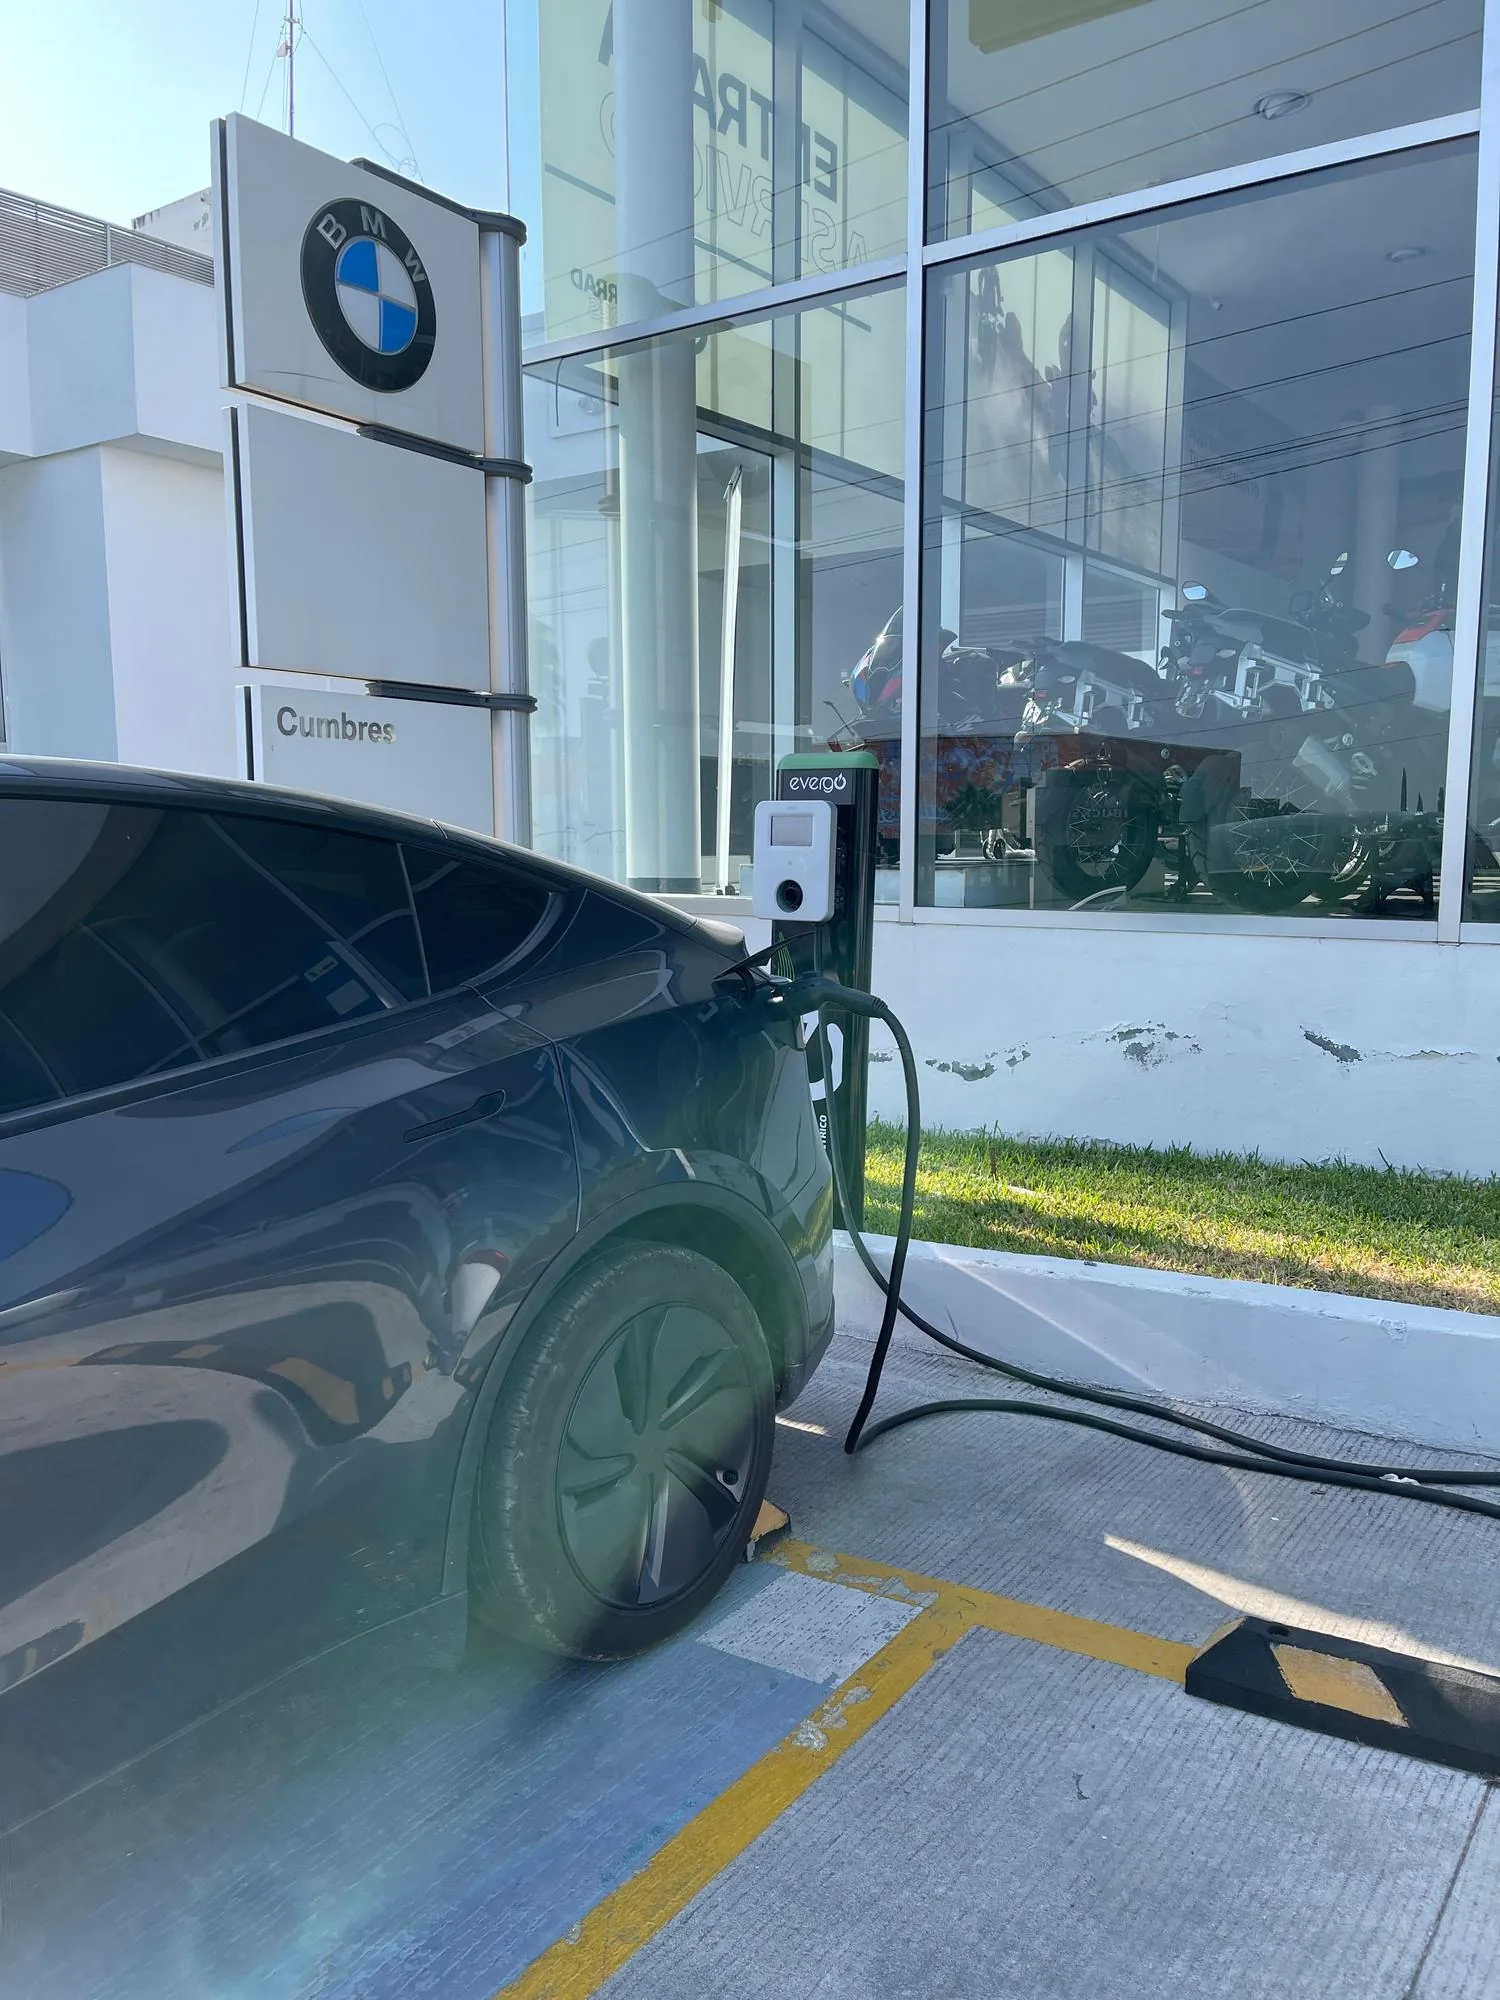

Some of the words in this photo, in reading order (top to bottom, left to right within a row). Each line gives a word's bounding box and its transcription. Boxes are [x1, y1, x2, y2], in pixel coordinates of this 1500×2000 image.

[316, 205, 428, 283] BMW
[276, 706, 397, 745] Cumbres
[789, 772, 847, 793] evergo
[819, 1114, 827, 1150] RICO
